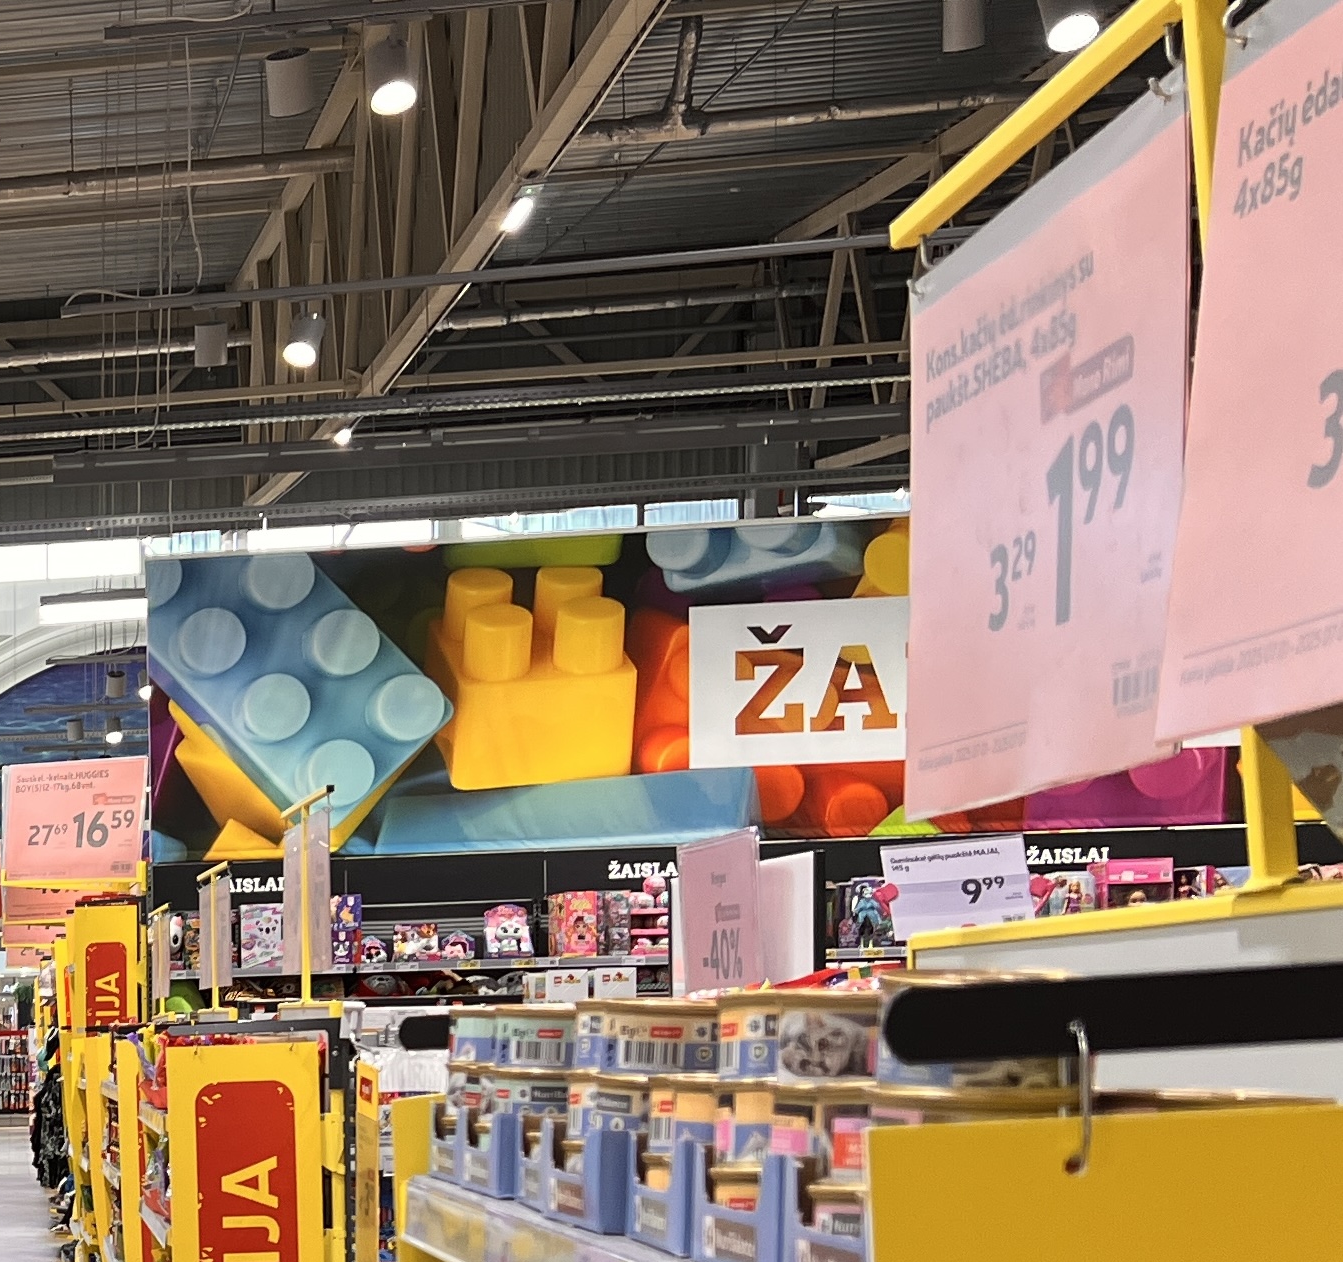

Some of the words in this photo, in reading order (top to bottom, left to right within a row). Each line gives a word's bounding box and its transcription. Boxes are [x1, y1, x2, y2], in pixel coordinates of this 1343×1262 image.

[1237, 99, 1298, 167] Kačių
[1300, 70, 1343, 126] ėda
[1232, 154, 1304, 219] 4x85g
[1046, 405, 1135, 626] 199
[28, 824, 68, 846] 2769
[73, 809, 135, 848] 1659
[607, 860, 679, 879] ŽAISLA
[1026, 846, 1110, 864] ŽAISLAI
[961, 876, 1005, 904] 999
[95, 971, 120, 1017] IJA
